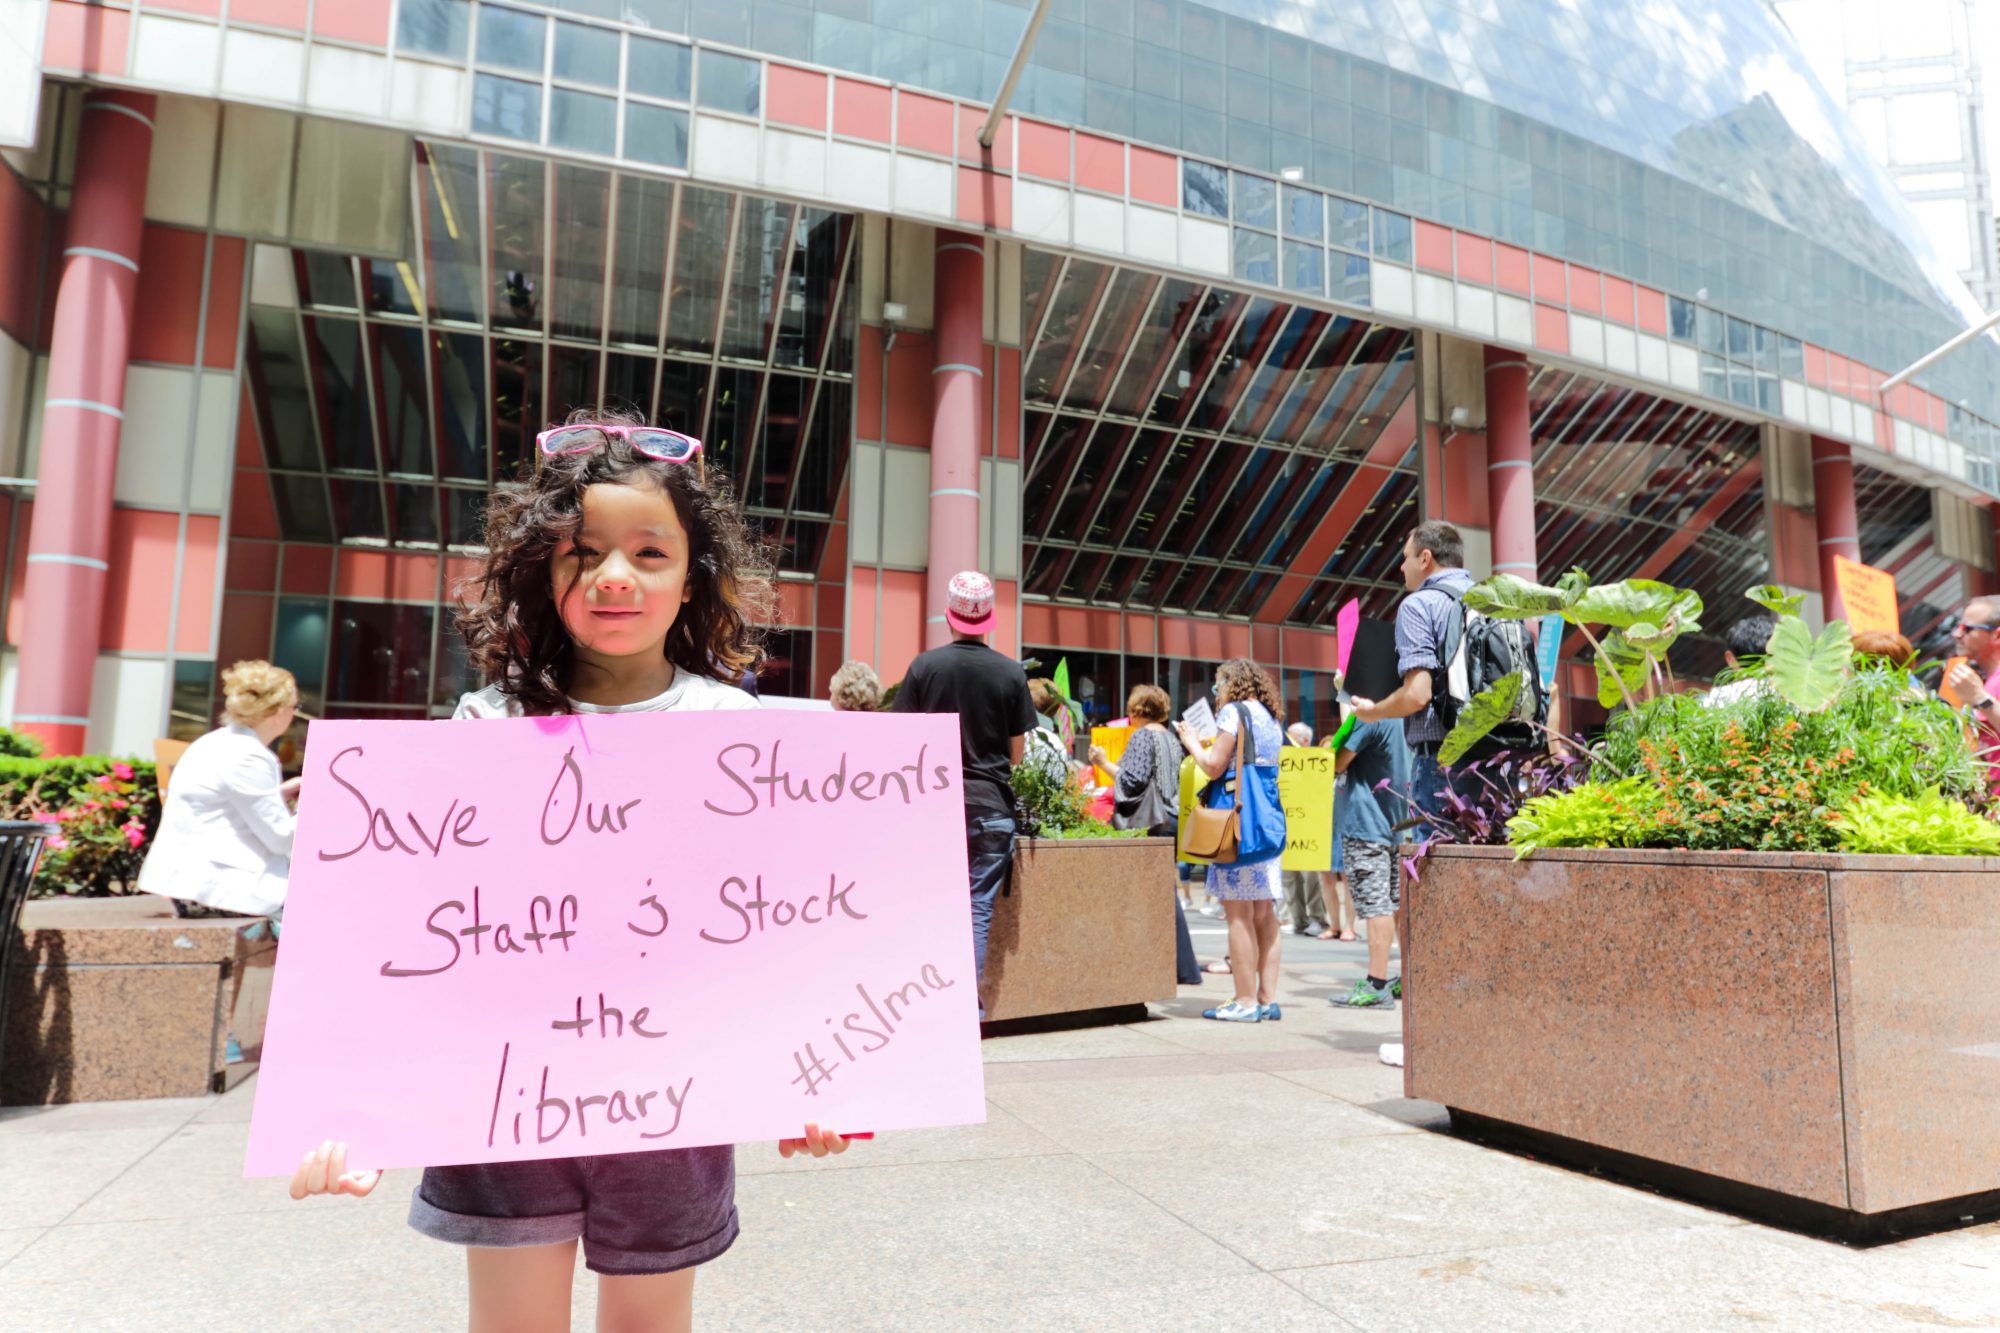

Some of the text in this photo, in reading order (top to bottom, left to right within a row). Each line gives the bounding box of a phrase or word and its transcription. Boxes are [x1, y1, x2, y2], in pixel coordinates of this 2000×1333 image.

[318, 738, 950, 862] Save Our Students
[1280, 757, 1328, 773] ENTS
[1285, 806, 1306, 819] ES
[380, 885, 579, 978] Staff
[699, 873, 867, 945] Stock
[551, 993, 668, 1038] the
[488, 1042, 693, 1149] library
